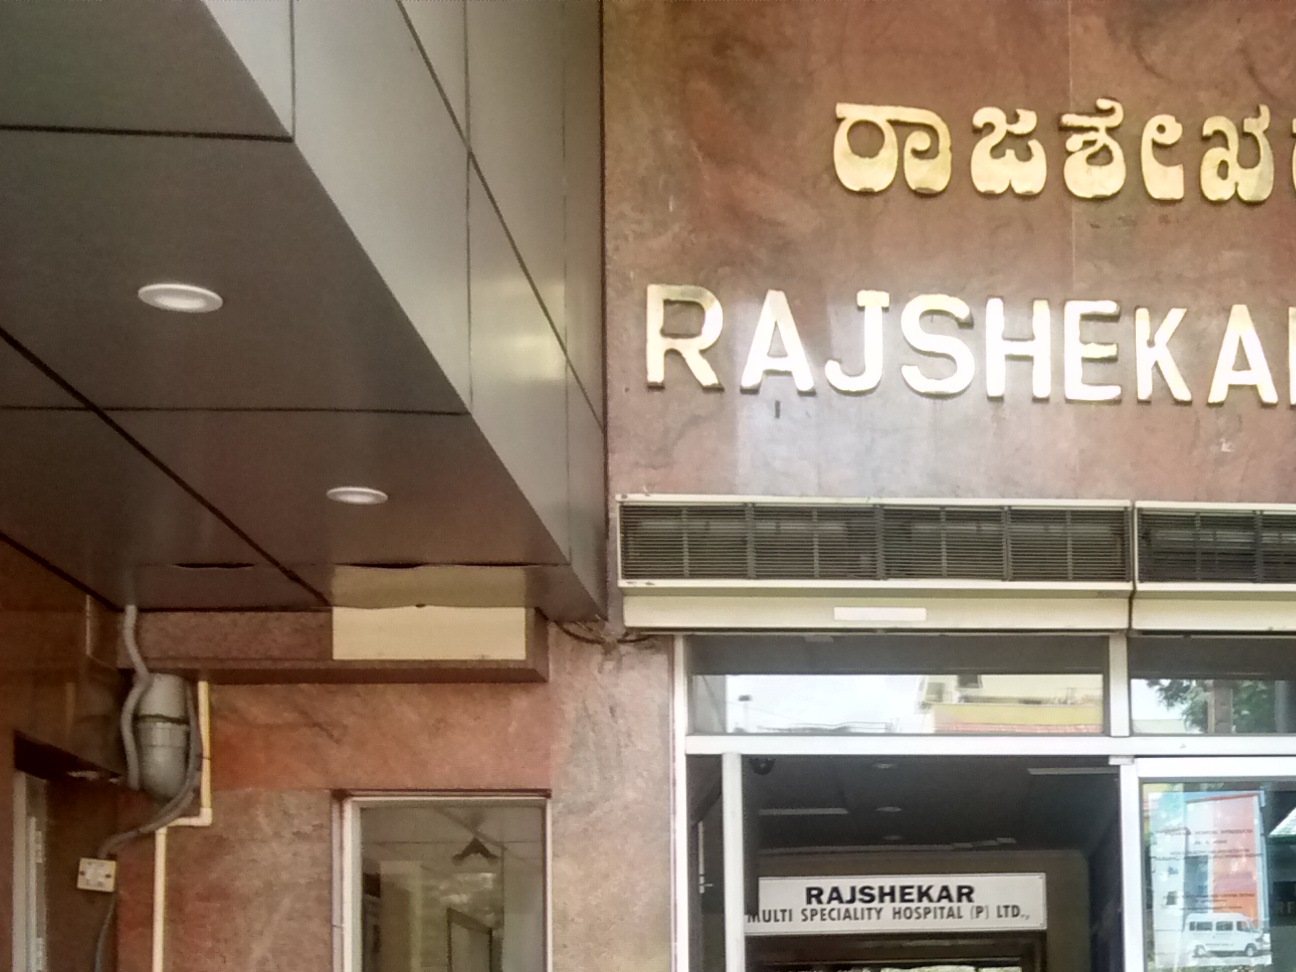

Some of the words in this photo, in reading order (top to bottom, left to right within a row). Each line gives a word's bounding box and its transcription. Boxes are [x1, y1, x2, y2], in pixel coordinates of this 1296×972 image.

[805, 884, 975, 906] RAJSHEKAR
[800, 906, 884, 923] SPECIALITY
[892, 904, 964, 920] HOSPITAL
